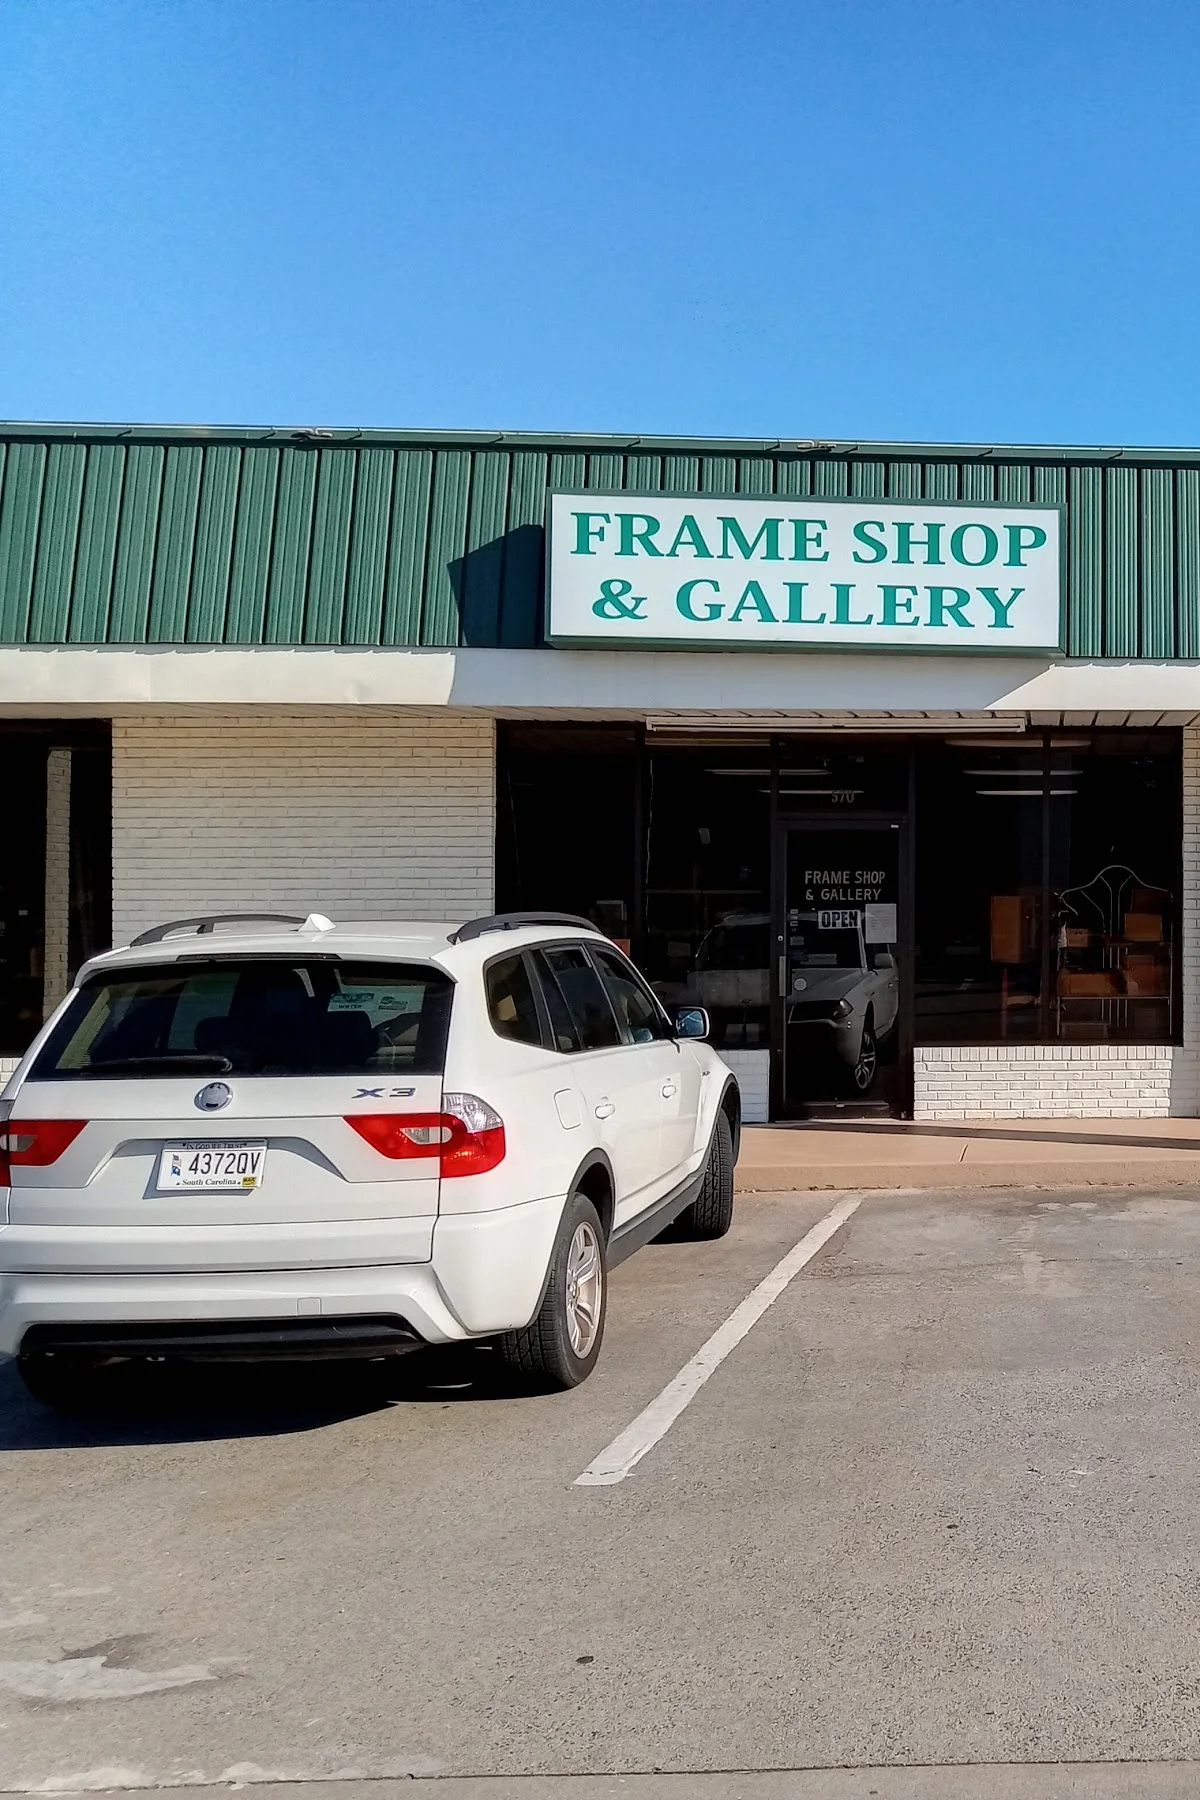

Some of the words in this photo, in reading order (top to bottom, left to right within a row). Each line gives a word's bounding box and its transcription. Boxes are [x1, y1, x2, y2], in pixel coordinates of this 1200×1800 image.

[570, 511, 829, 562] FRAME
[852, 520, 1047, 567] SHOP
[592, 578, 648, 620] &
[676, 578, 1025, 629] GALLERY
[804, 870, 850, 884] FRAME
[854, 870, 886, 884] SHOP
[805, 889, 814, 900] &
[820, 888, 882, 901] GALLERY
[821, 911, 858, 928] OPEN
[351, 1087, 416, 1099] X3
[188, 1152, 261, 1175] 4372QV
[182, 1178, 204, 1186] South
[205, 1178, 236, 1186] Carolina
